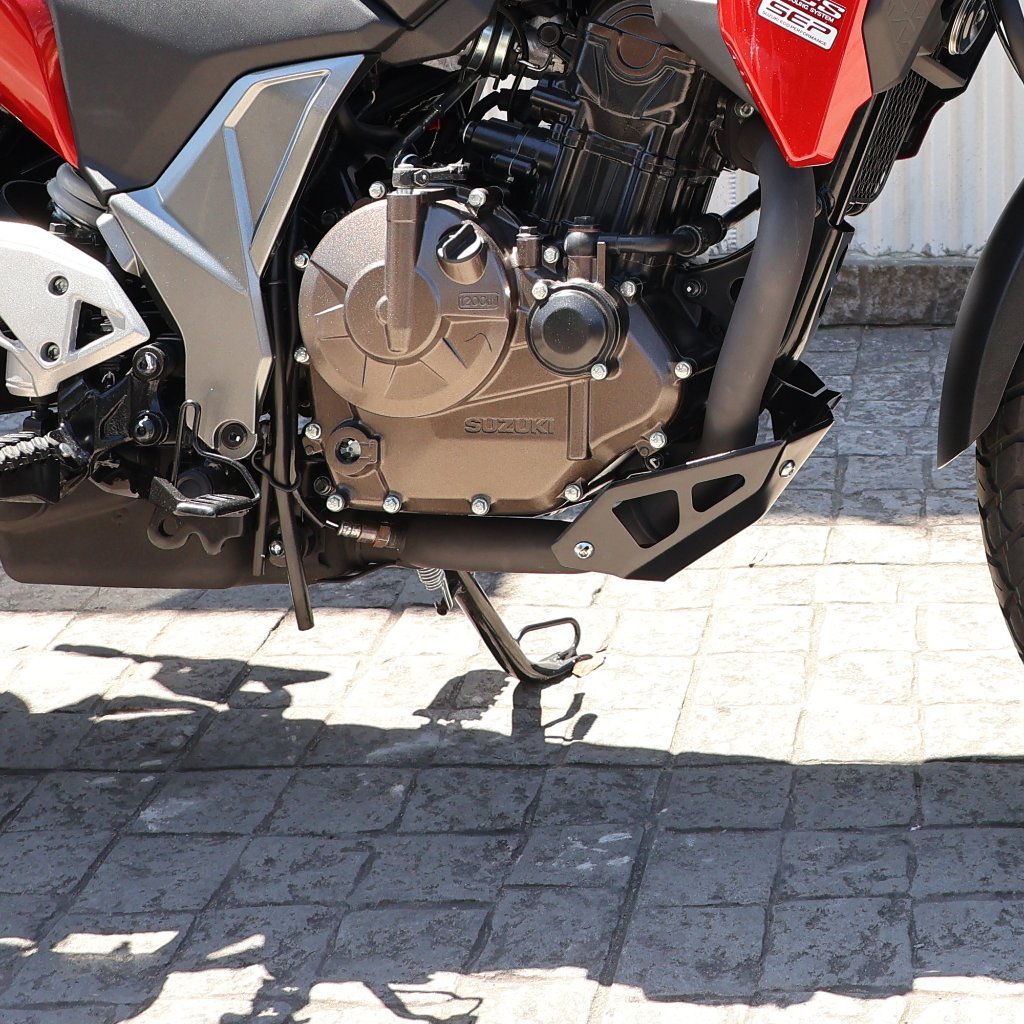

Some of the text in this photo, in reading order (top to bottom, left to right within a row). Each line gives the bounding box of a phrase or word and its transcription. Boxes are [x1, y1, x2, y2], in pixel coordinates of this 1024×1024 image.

[762, 10, 779, 22] SUZUKI
[790, 25, 827, 46] PERFORMANCE
[765, 0, 832, 35] SEP
[809, 6, 835, 23] SYSTEM
[464, 416, 554, 436] SUZUKI
